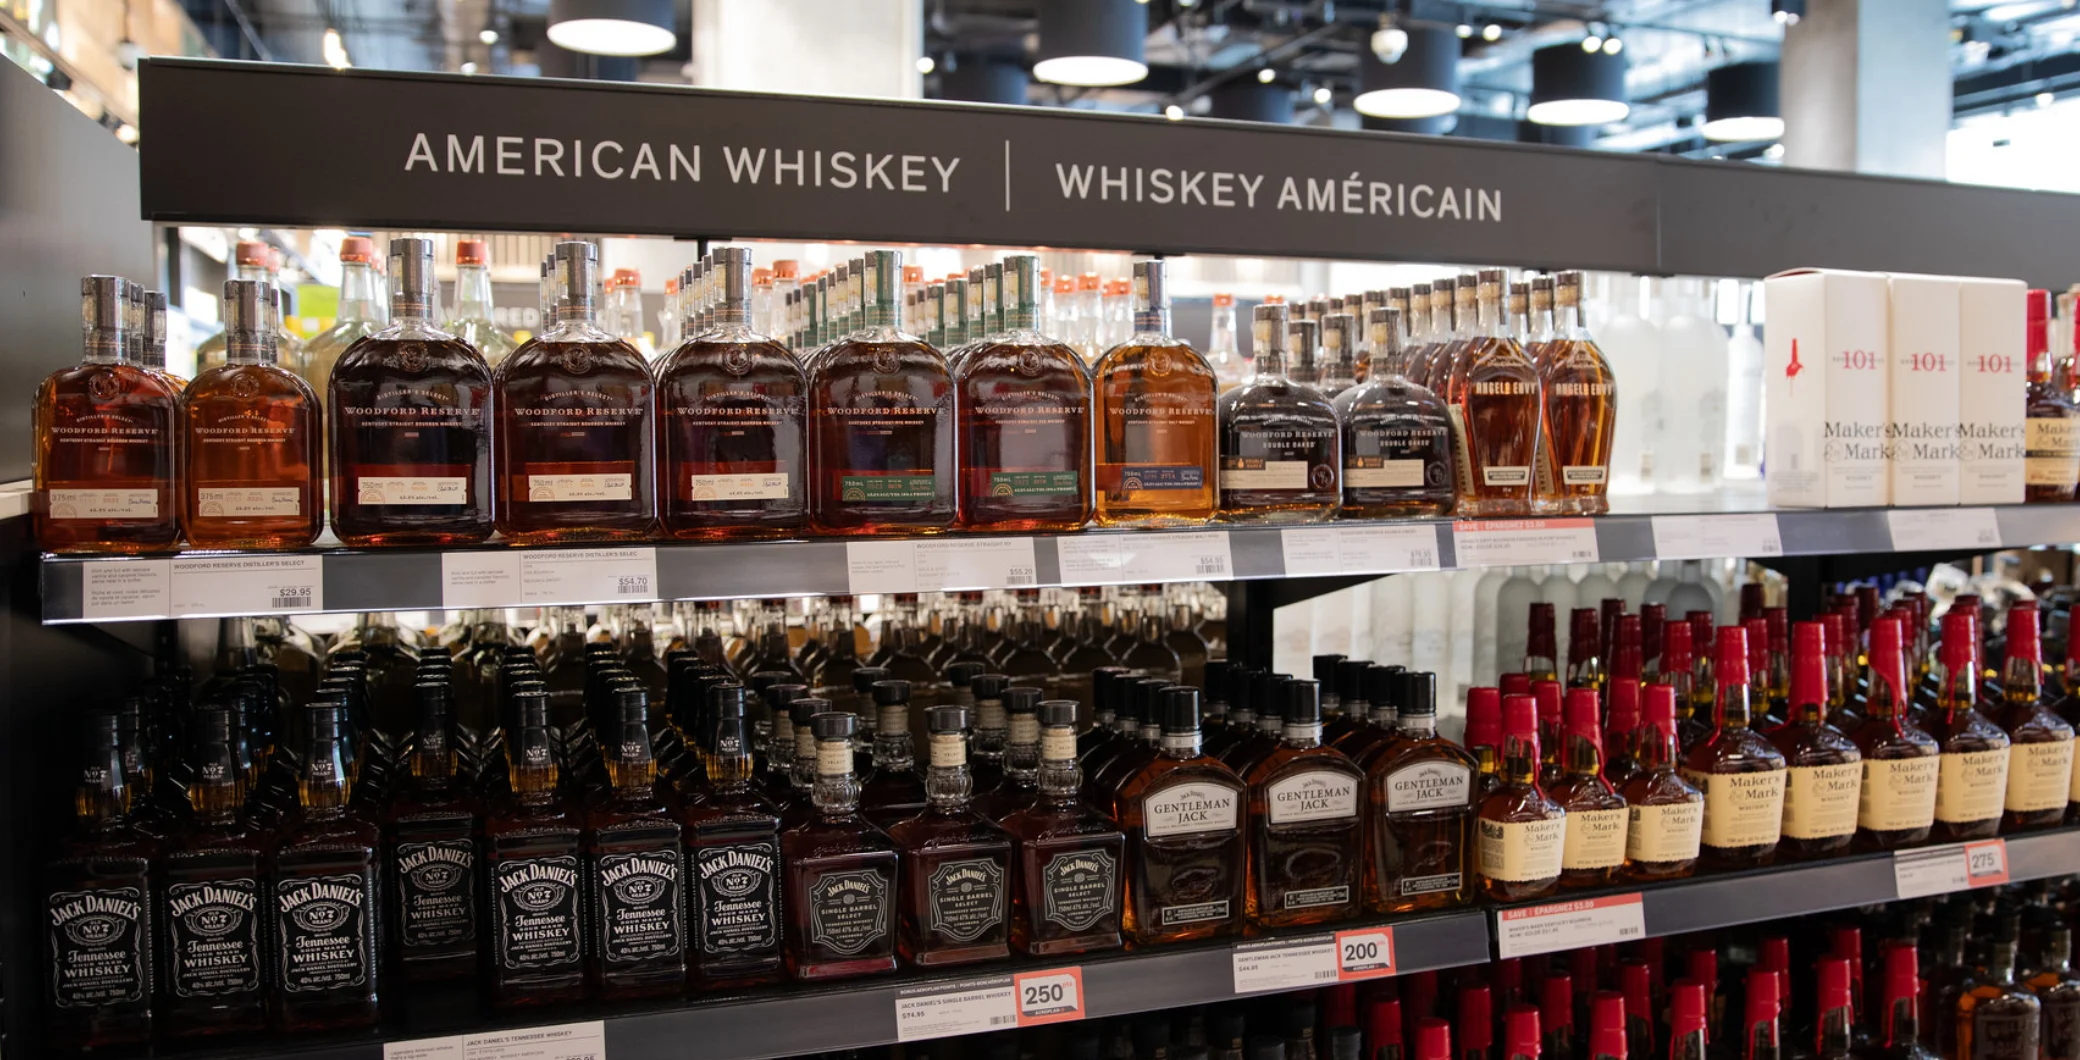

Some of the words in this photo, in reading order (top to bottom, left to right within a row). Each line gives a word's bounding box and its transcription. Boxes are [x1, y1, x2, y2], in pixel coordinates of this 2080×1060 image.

[404, 132, 701, 183] AMERICAN
[723, 145, 961, 193] WHISKEY
[1056, 162, 1264, 207] WHISKEY
[1277, 171, 1501, 222] AMÉRICAIN
[1842, 349, 1877, 370] 101
[1911, 352, 1947, 372] 101
[1977, 354, 2013, 374] 101
[1512, 381, 1537, 395] ENVY
[344, 407, 417, 415] WOODFORD
[421, 407, 480, 416] RESERVE
[515, 407, 583, 416] WOODFORD
[587, 407, 642, 416] RESERVE
[677, 407, 742, 416] WOODFORD
[746, 407, 797, 415] RESERVE
[827, 407, 890, 415] WOODFORD
[893, 407, 945, 415] RESERVE
[975, 406, 1035, 414] WOODFORD
[1037, 406, 1085, 414] RESERVE
[1109, 407, 1165, 415] WOODFORD
[1168, 407, 1213, 415] RESERVE
[51, 427, 108, 435] WOODFORD
[111, 427, 159, 435] RESERVE
[1359, 429, 1409, 437] WOODFORD
[1824, 421, 1891, 439] Maker's
[1891, 421, 1958, 439] Maker's
[1958, 421, 2025, 439] Maker's
[1844, 443, 1890, 460] Mark
[1912, 443, 1959, 460] Mark
[1977, 443, 2026, 459] Mark
[173, 562, 211, 570] WOODFORD
[281, 559, 305, 567] SELECT
[618, 577, 648, 586] $54.70
[279, 587, 312, 597] $29.95
[2041, 756, 2068, 766] Mark
[1975, 765, 2004, 776] Mark
[1395, 776, 1464, 791] GENTLEMAN
[1827, 779, 1857, 791] Mark
[1903, 773, 1933, 785] Mark
[1277, 786, 1350, 802] GENTLEMAN
[1416, 788, 1443, 800] JACK
[1744, 786, 1779, 800] Mark
[1154, 798, 1231, 815] GENTLEMAN
[1300, 799, 1329, 811] JACK
[1178, 811, 1208, 824] JACK
[1672, 814, 1696, 825] Mark
[1592, 822, 1619, 832] Mark
[1535, 831, 1559, 841] Mark
[397, 851, 427, 875] JACK
[427, 846, 475, 869] DANIEL'S
[699, 856, 728, 880] JACK
[727, 851, 774, 874] DANIEL'S
[1972, 853, 1994, 868] 275
[601, 863, 629, 887] JACK
[630, 857, 678, 881] DANIEL'S
[1060, 862, 1076, 876] JACK
[1075, 859, 1099, 873] DANIEL'S
[499, 868, 529, 893] JACK
[528, 863, 578, 888] DANIEL'S
[945, 871, 962, 886] JACK
[961, 868, 987, 882] DANIEL'S
[827, 882, 845, 897] JACK
[844, 879, 871, 894] DANIEL'S
[1053, 885, 1077, 893] SINGLE
[1079, 882, 1105, 890] BARREL
[1068, 890, 1091, 898] SELECT
[169, 890, 203, 918] JACK
[203, 886, 257, 912] DANIEL'S
[278, 885, 313, 913] JACK
[311, 882, 364, 908] DANIEL'S
[413, 894, 463, 906] Tennessee
[940, 895, 965, 904] SINGLE
[966, 892, 993, 900] BARREL
[954, 900, 978, 908] SELECT
[50, 900, 86, 926] JACK
[85, 895, 141, 921] DANIEL'S
[714, 900, 762, 913] Tennessee
[821, 906, 848, 915] SINGLE
[849, 903, 878, 912] BARREL
[410, 907, 467, 920] WHISKEY
[616, 908, 666, 921] Tennessee
[711, 912, 766, 926] WHISKEY
[837, 912, 862, 920] SELECT
[1508, 909, 1527, 919] SAVE
[515, 914, 566, 927] Tennessee
[613, 921, 670, 935] WHISKEY
[512, 928, 570, 942] WHISKEY
[187, 940, 244, 953] Tennessee
[295, 935, 350, 949] Tennessee
[68, 950, 126, 963] Tennessee
[291, 949, 355, 964] WHISKEY
[1345, 942, 1378, 961] 200
[184, 953, 248, 968] WHISKEY
[64, 964, 131, 978] WHISKEY
[916, 1000, 942, 1008] DANIEL'S
[942, 997, 962, 1005] SINGLE
[986, 991, 1012, 999] WHISKEY
[1025, 984, 1063, 1006] 250
[902, 1011, 925, 1019] $74.95
[484, 1037, 510, 1045] DANIEL'S
[511, 1034, 545, 1042] TENNESSEE
